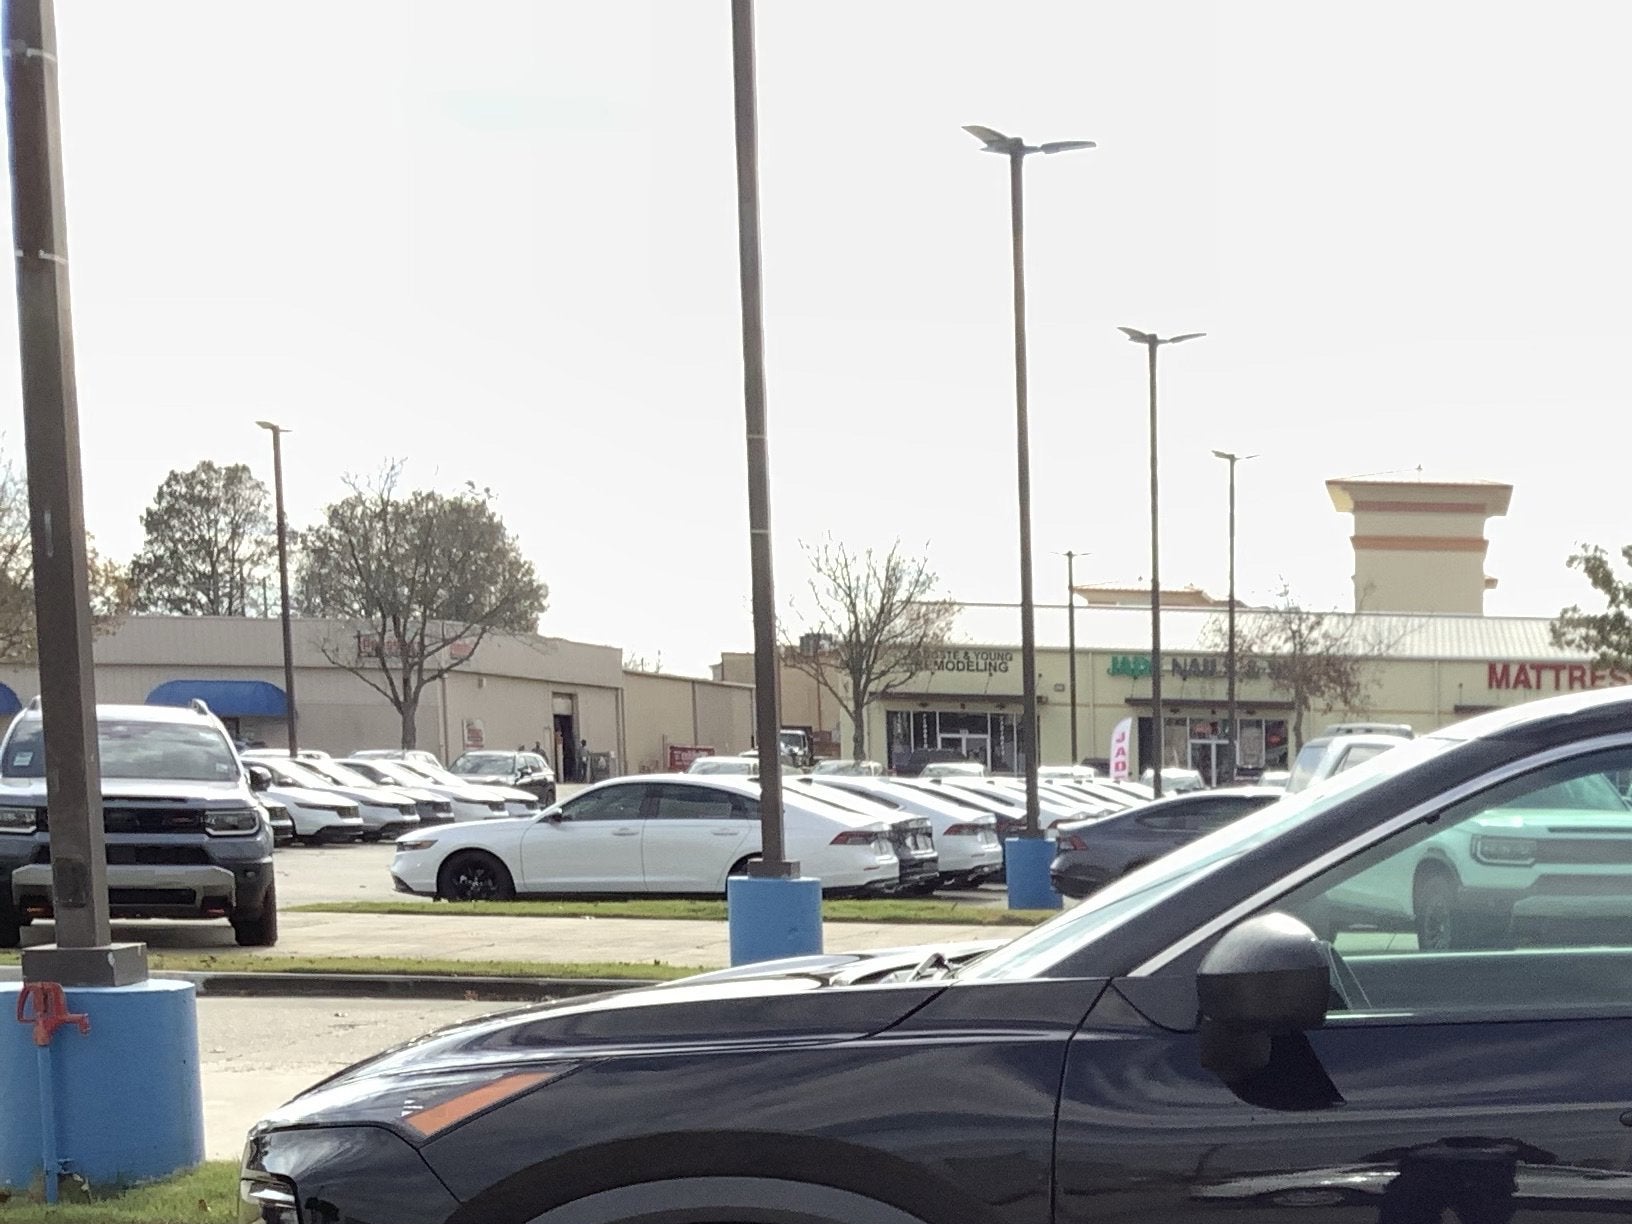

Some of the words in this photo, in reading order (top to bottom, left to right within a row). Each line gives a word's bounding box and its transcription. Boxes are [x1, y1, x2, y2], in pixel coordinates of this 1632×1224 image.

[974, 651, 1013, 661] YOUNG
[1107, 656, 1157, 677] JAD
[1114, 731, 1127, 779] JAD
